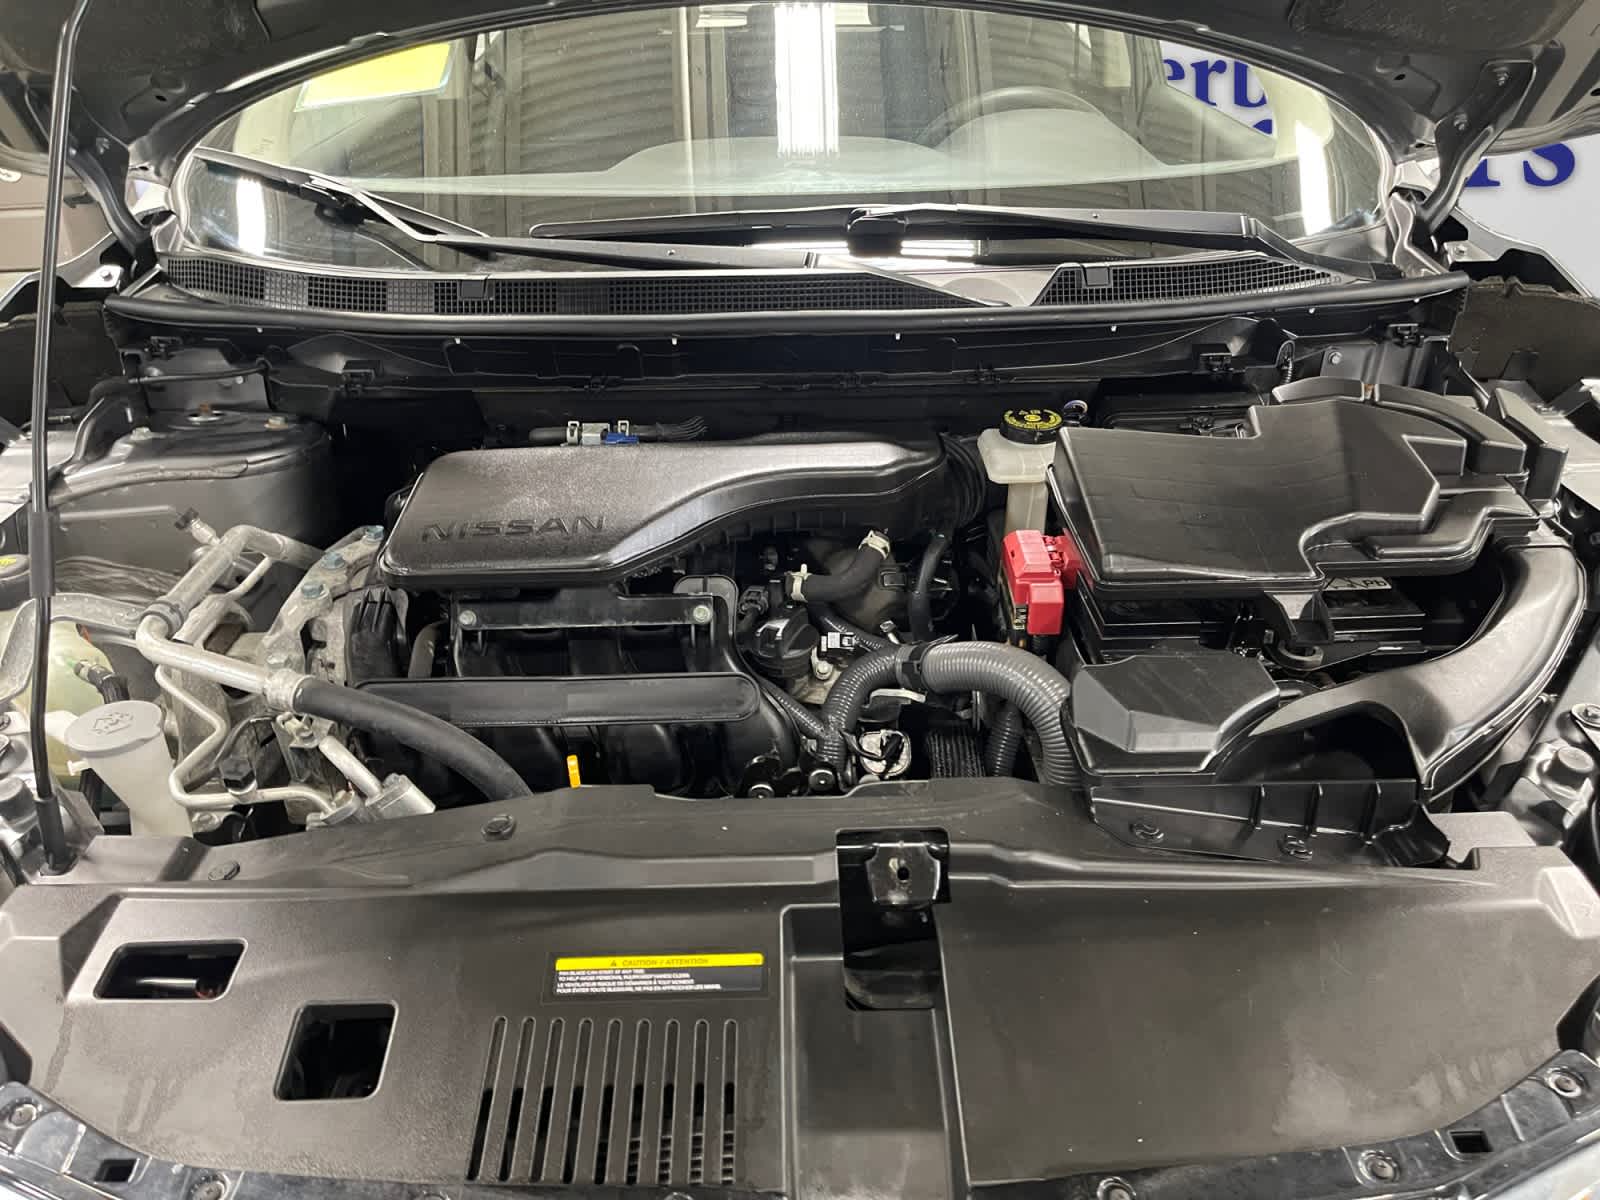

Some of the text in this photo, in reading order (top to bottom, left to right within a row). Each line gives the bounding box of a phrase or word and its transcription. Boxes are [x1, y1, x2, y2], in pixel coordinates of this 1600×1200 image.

[421, 515, 606, 542] NISSAN
[622, 959, 657, 967] CAUTION
[665, 958, 709, 966] ATTENTION
